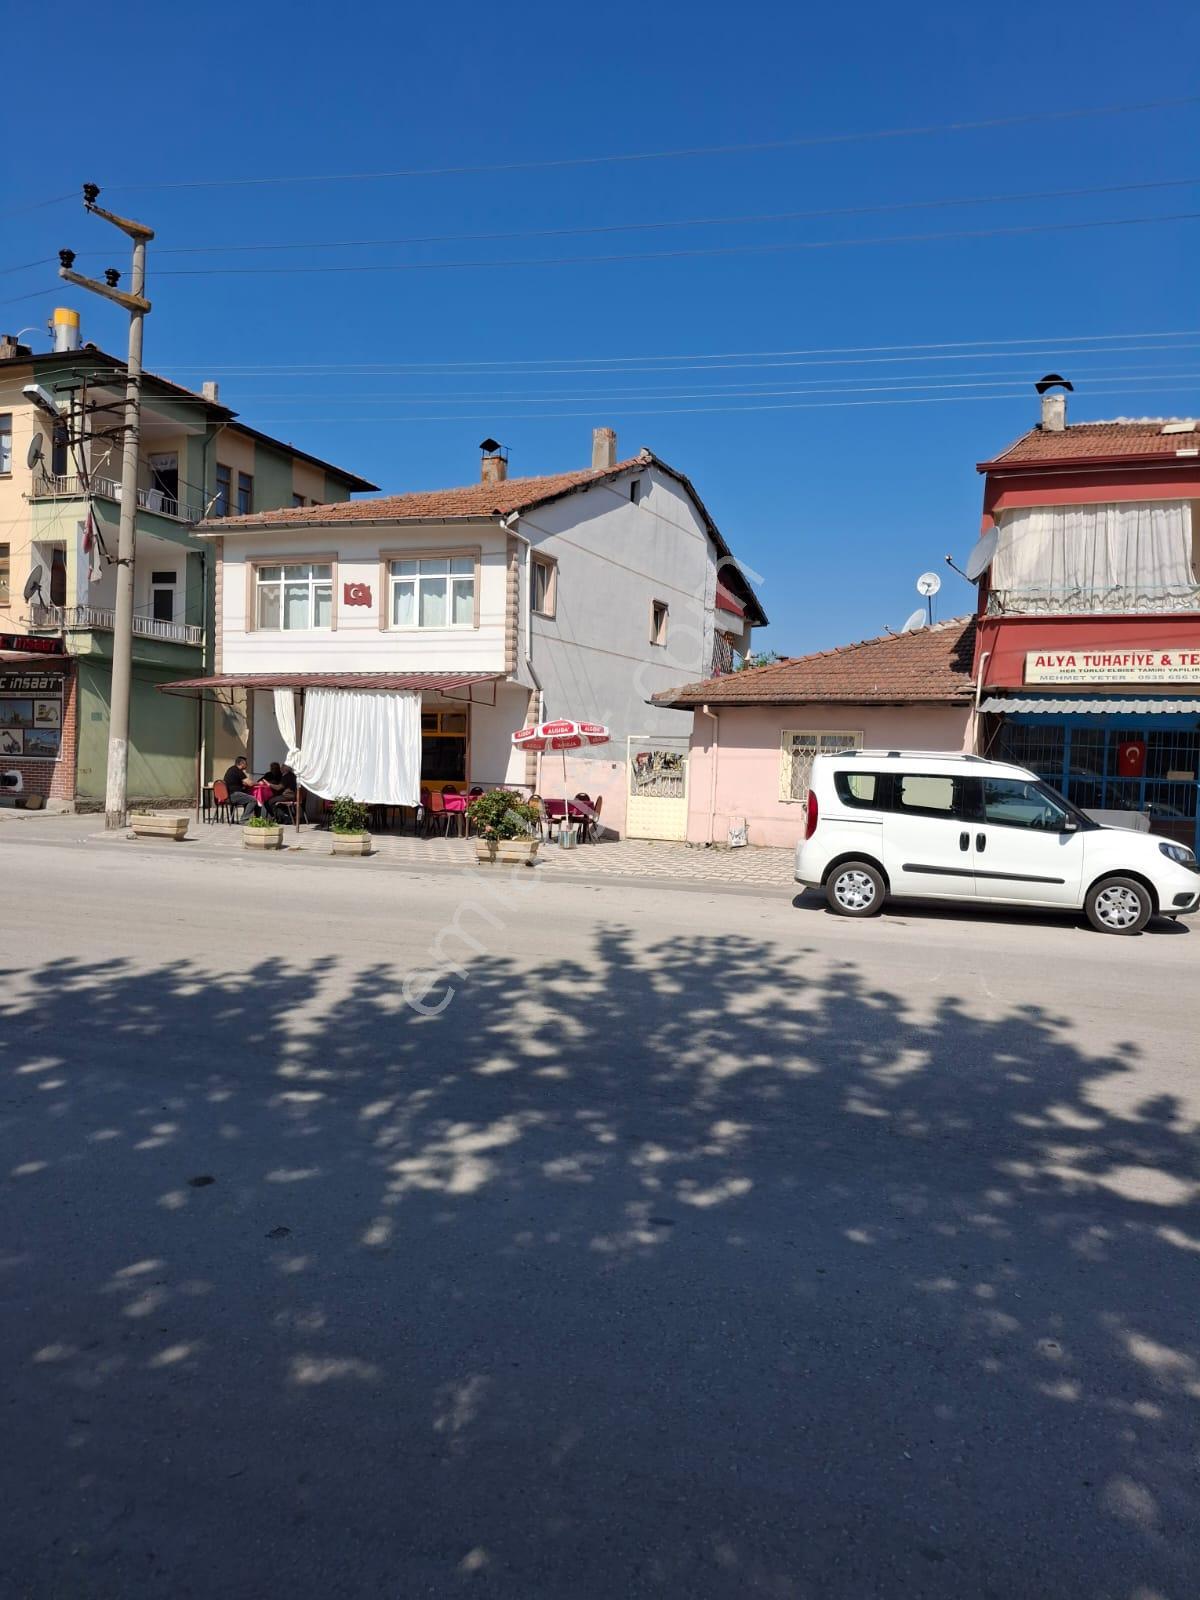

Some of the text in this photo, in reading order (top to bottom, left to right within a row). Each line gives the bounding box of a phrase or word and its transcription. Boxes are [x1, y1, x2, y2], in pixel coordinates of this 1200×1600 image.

[1035, 652, 1200, 667] ALYA TUHAFİYE & TE
